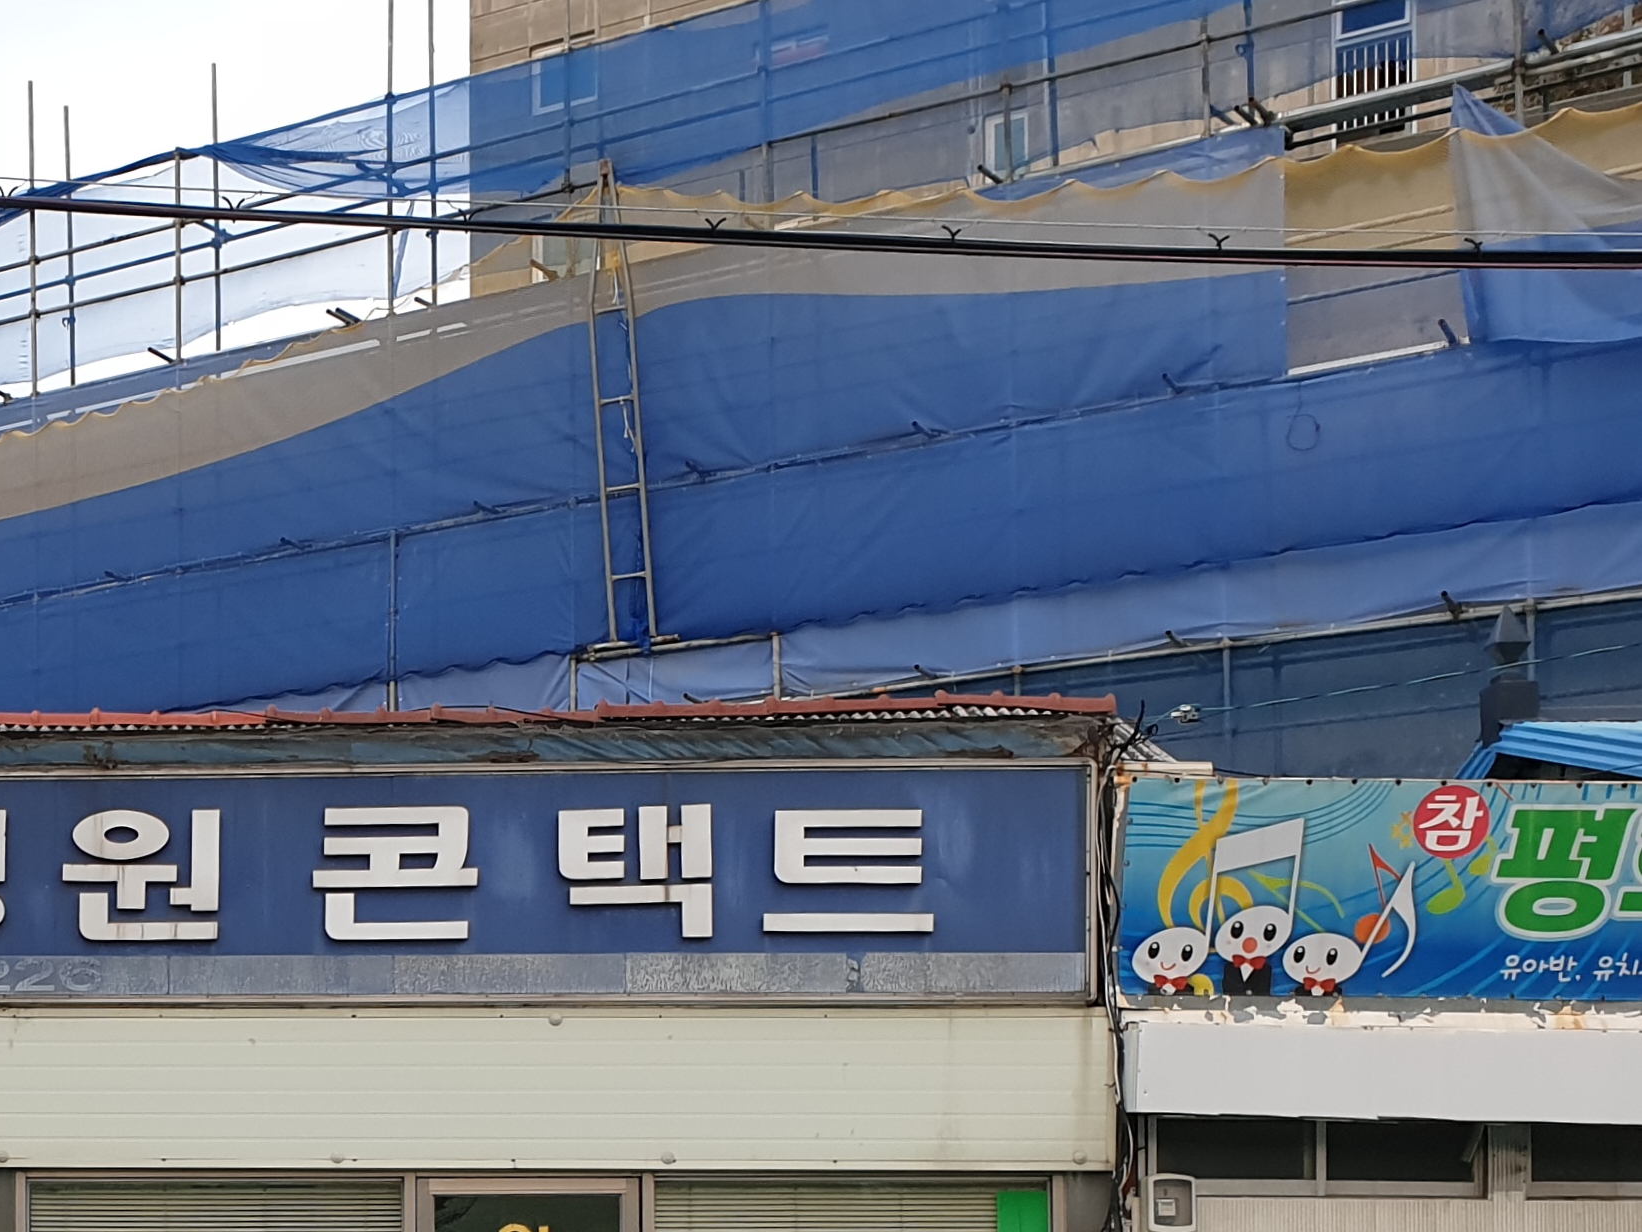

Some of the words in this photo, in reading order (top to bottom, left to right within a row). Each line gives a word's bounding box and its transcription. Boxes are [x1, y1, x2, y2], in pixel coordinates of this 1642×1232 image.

[312, 803, 935, 940] 콘택트
[1418, 794, 1485, 852] 참
[1495, 808, 1642, 933] 평
[1593, 952, 1642, 982] 유치
